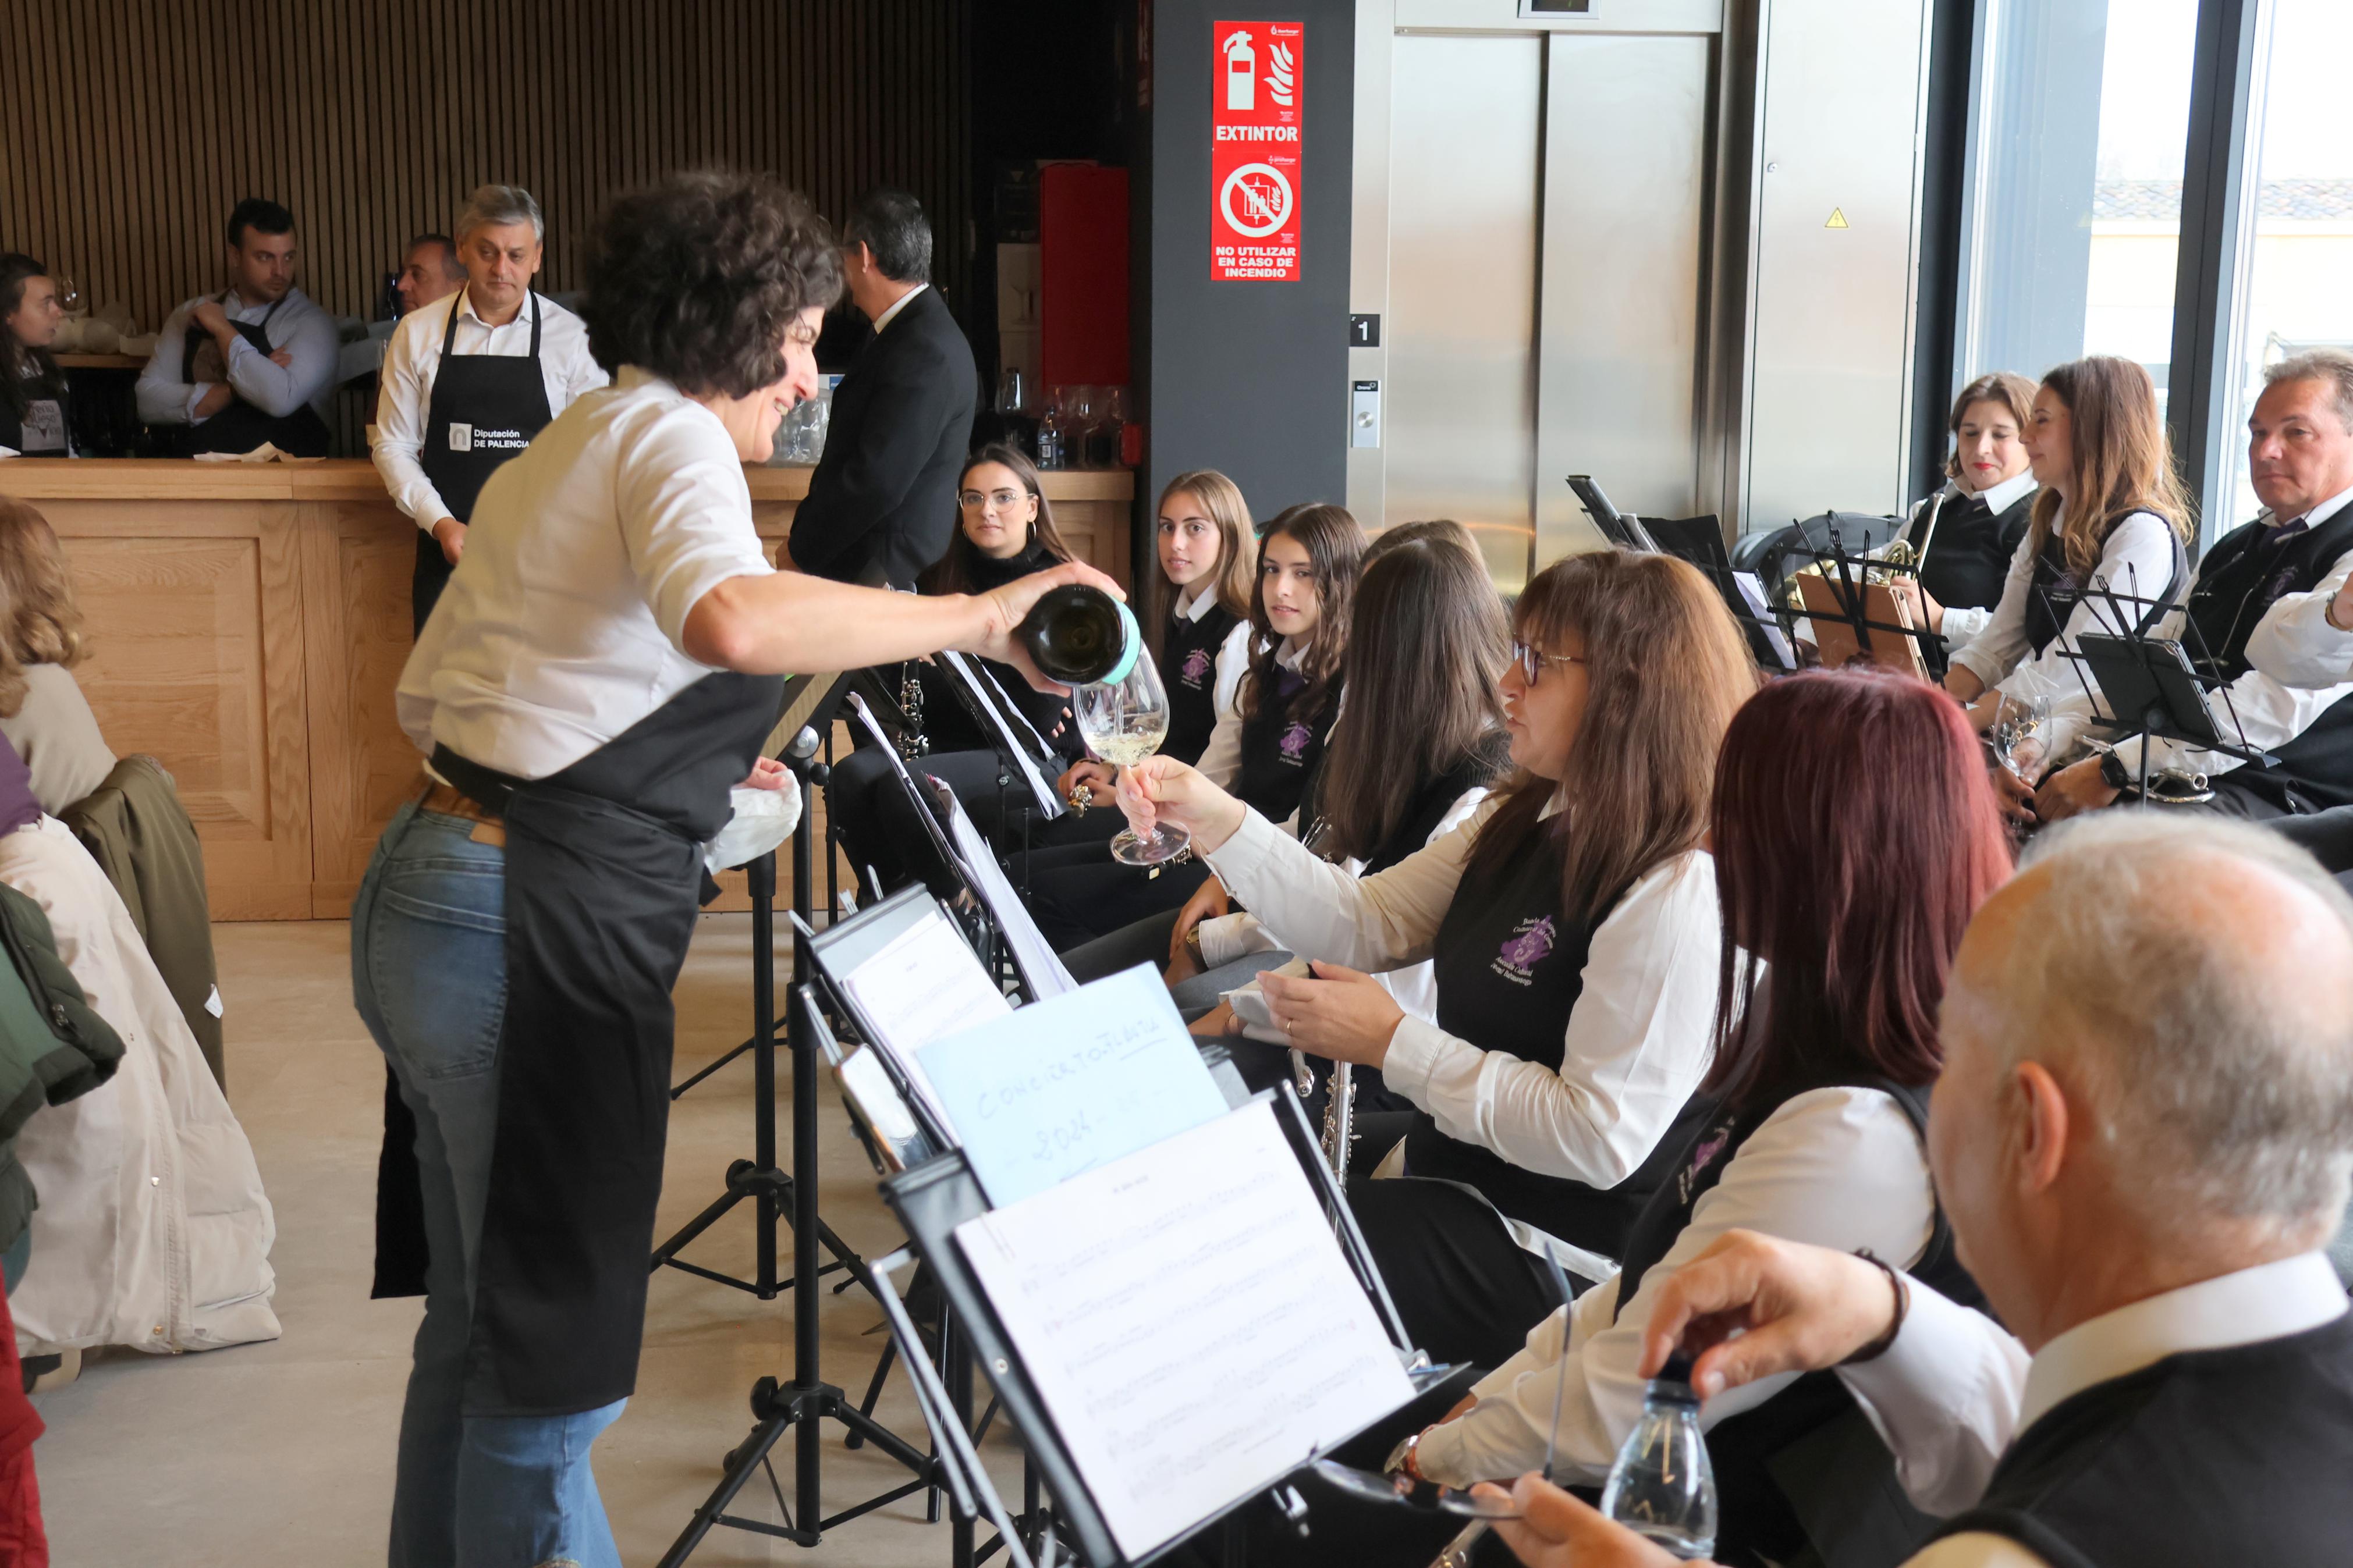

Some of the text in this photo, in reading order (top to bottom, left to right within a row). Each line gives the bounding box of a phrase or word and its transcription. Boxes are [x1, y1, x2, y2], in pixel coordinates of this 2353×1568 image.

[1216, 126, 1298, 141] EXTINTOR
[1216, 247, 1296, 256] NO UTILIZAR
[1218, 257, 1293, 267] EN CASO DE
[1225, 268, 1286, 278] INCENDIO
[1358, 321, 1368, 340] 1
[474, 429, 520, 438] Diputación
[474, 439, 485, 447] DE
